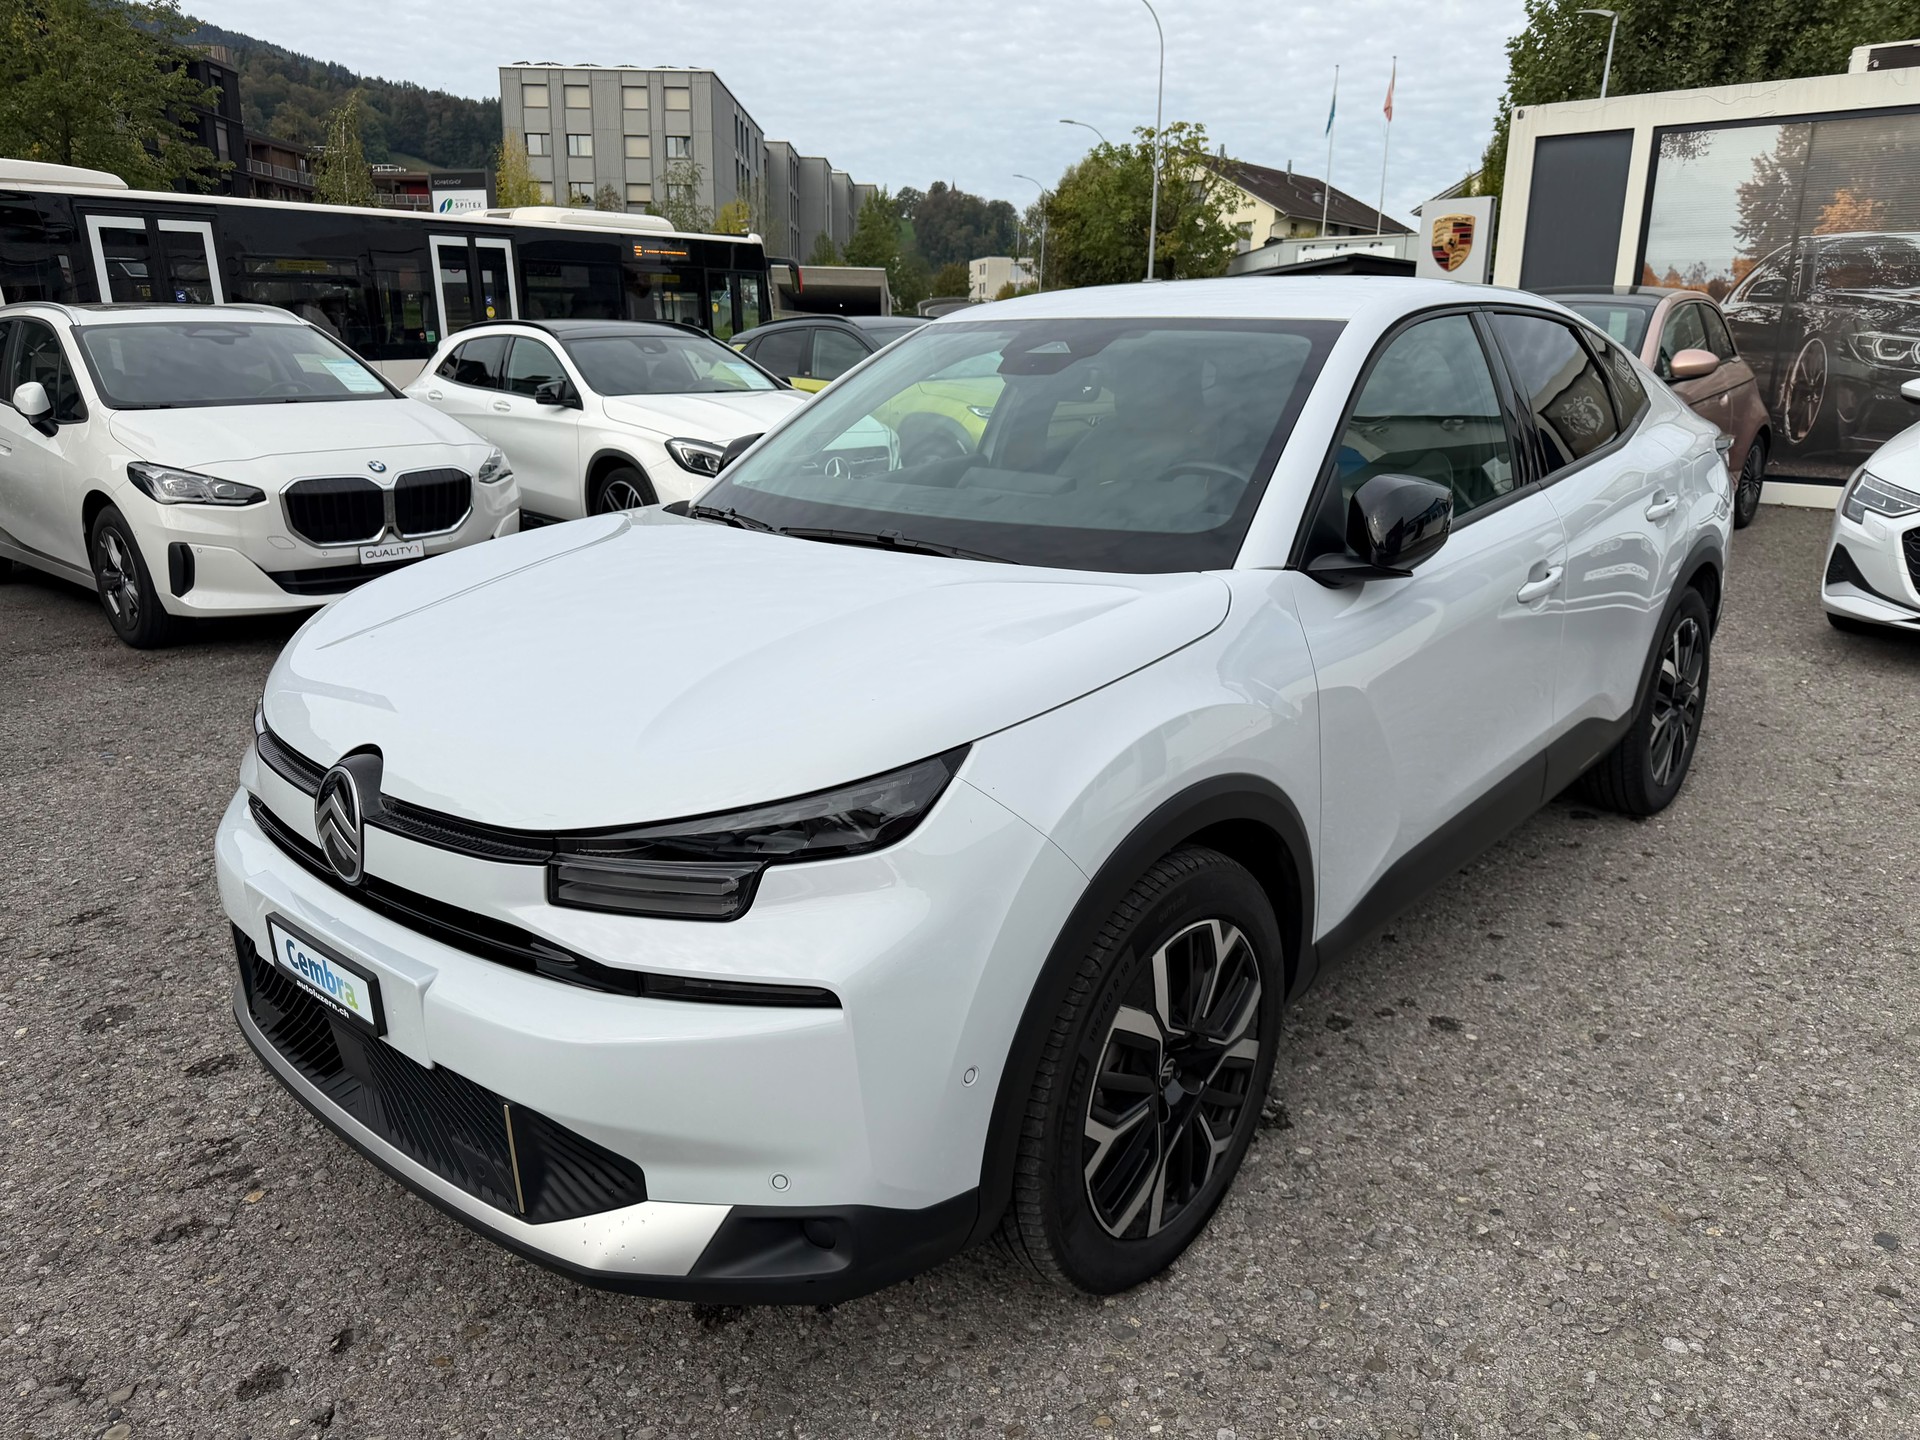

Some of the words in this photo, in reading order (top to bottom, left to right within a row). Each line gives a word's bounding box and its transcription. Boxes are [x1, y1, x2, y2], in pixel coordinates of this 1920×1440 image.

[365, 545, 413, 559] QUALITY
[286, 939, 358, 1010] Cembra
[296, 980, 350, 1019] autoluzern.ch
[1089, 991, 1113, 1042] 195/60
[1113, 978, 1120, 991] R
